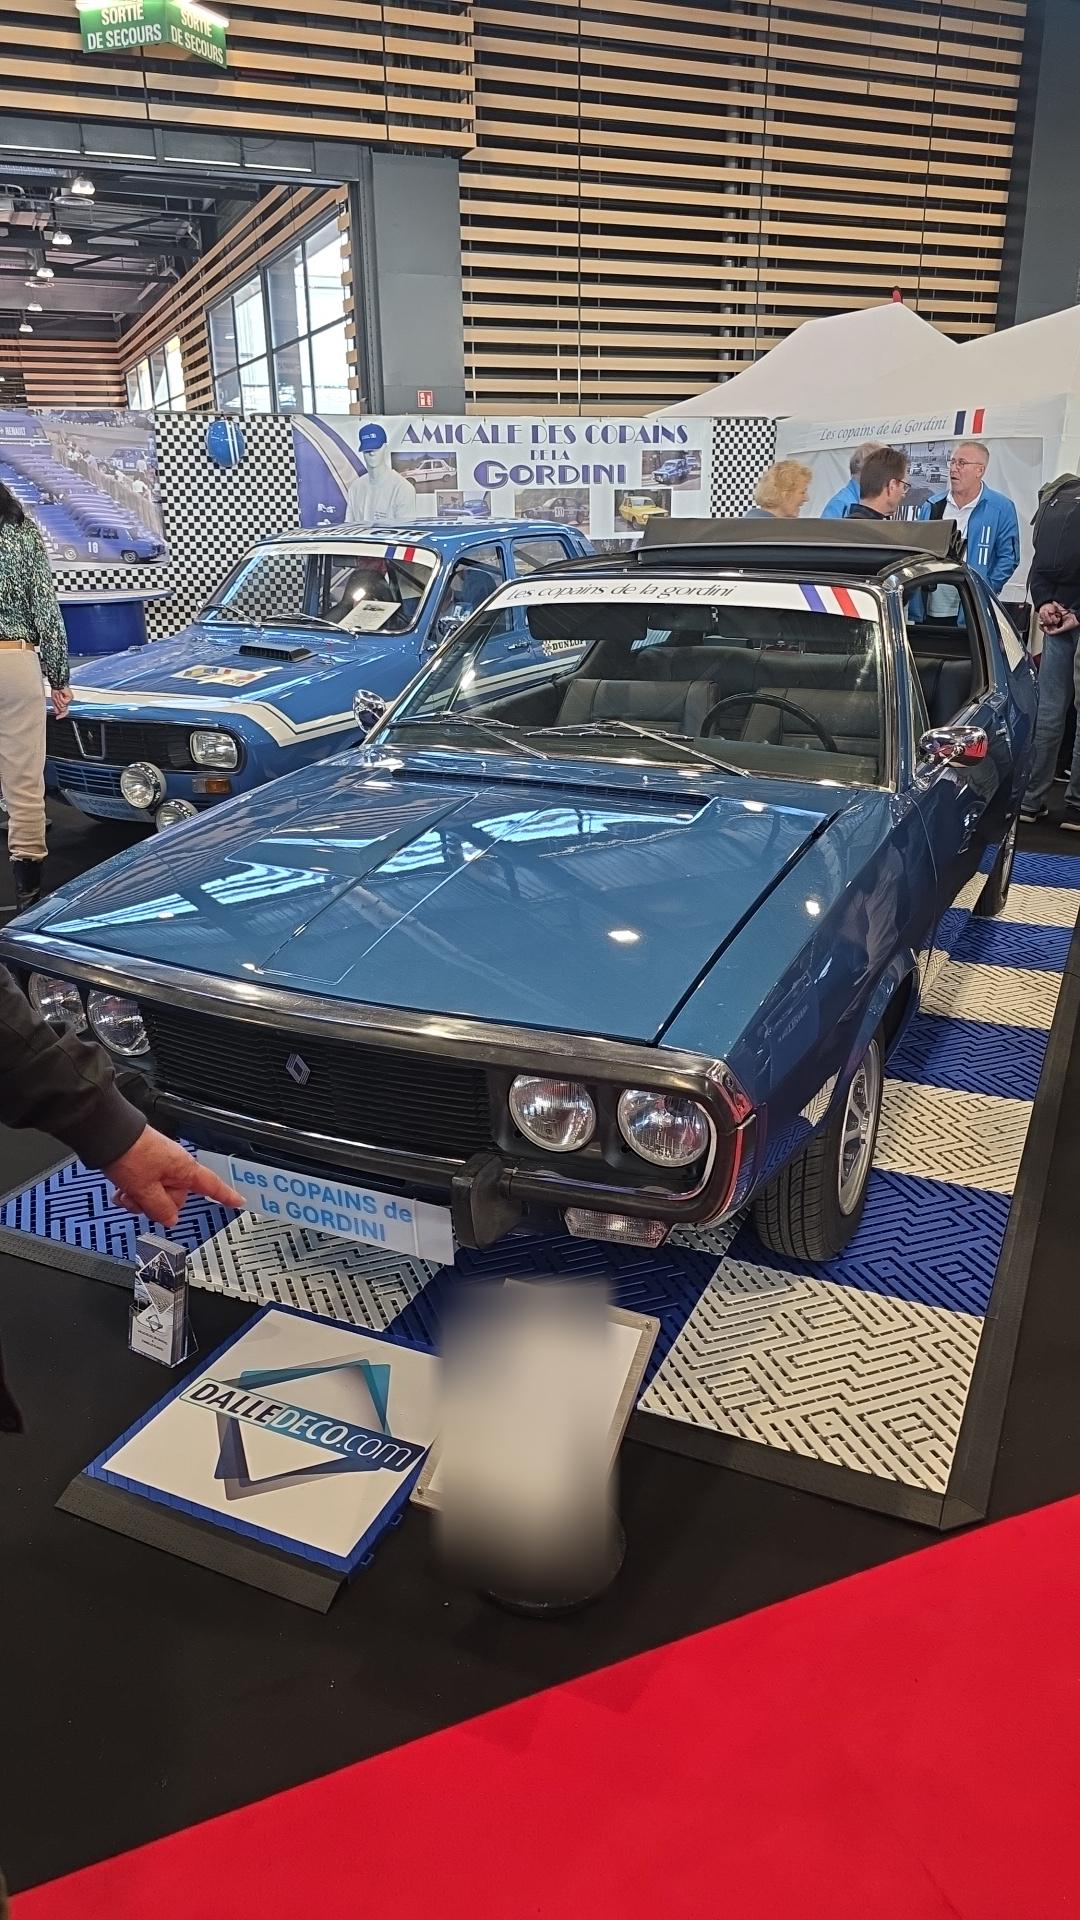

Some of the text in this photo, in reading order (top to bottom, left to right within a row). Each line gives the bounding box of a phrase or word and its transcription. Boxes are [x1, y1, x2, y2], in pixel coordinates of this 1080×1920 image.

[101, 3, 144, 25] SORTIE
[180, 8, 212, 37] SORTIE
[87, 33, 103, 50] DE
[170, 25, 224, 64] DE SECOURS
[401, 424, 689, 444] AMICALE DES COPAINS
[820, 415, 949, 442] Les copains de la Gordini
[531, 450, 570, 460] DE LA
[473, 460, 627, 490] GORDINI
[506, 583, 738, 600] Les copains de la gordini
[231, 1164, 413, 1223] Les COPAINS de
[260, 1194, 386, 1241] la GORDINI
[189, 1383, 413, 1467] DALLEDECO.com
